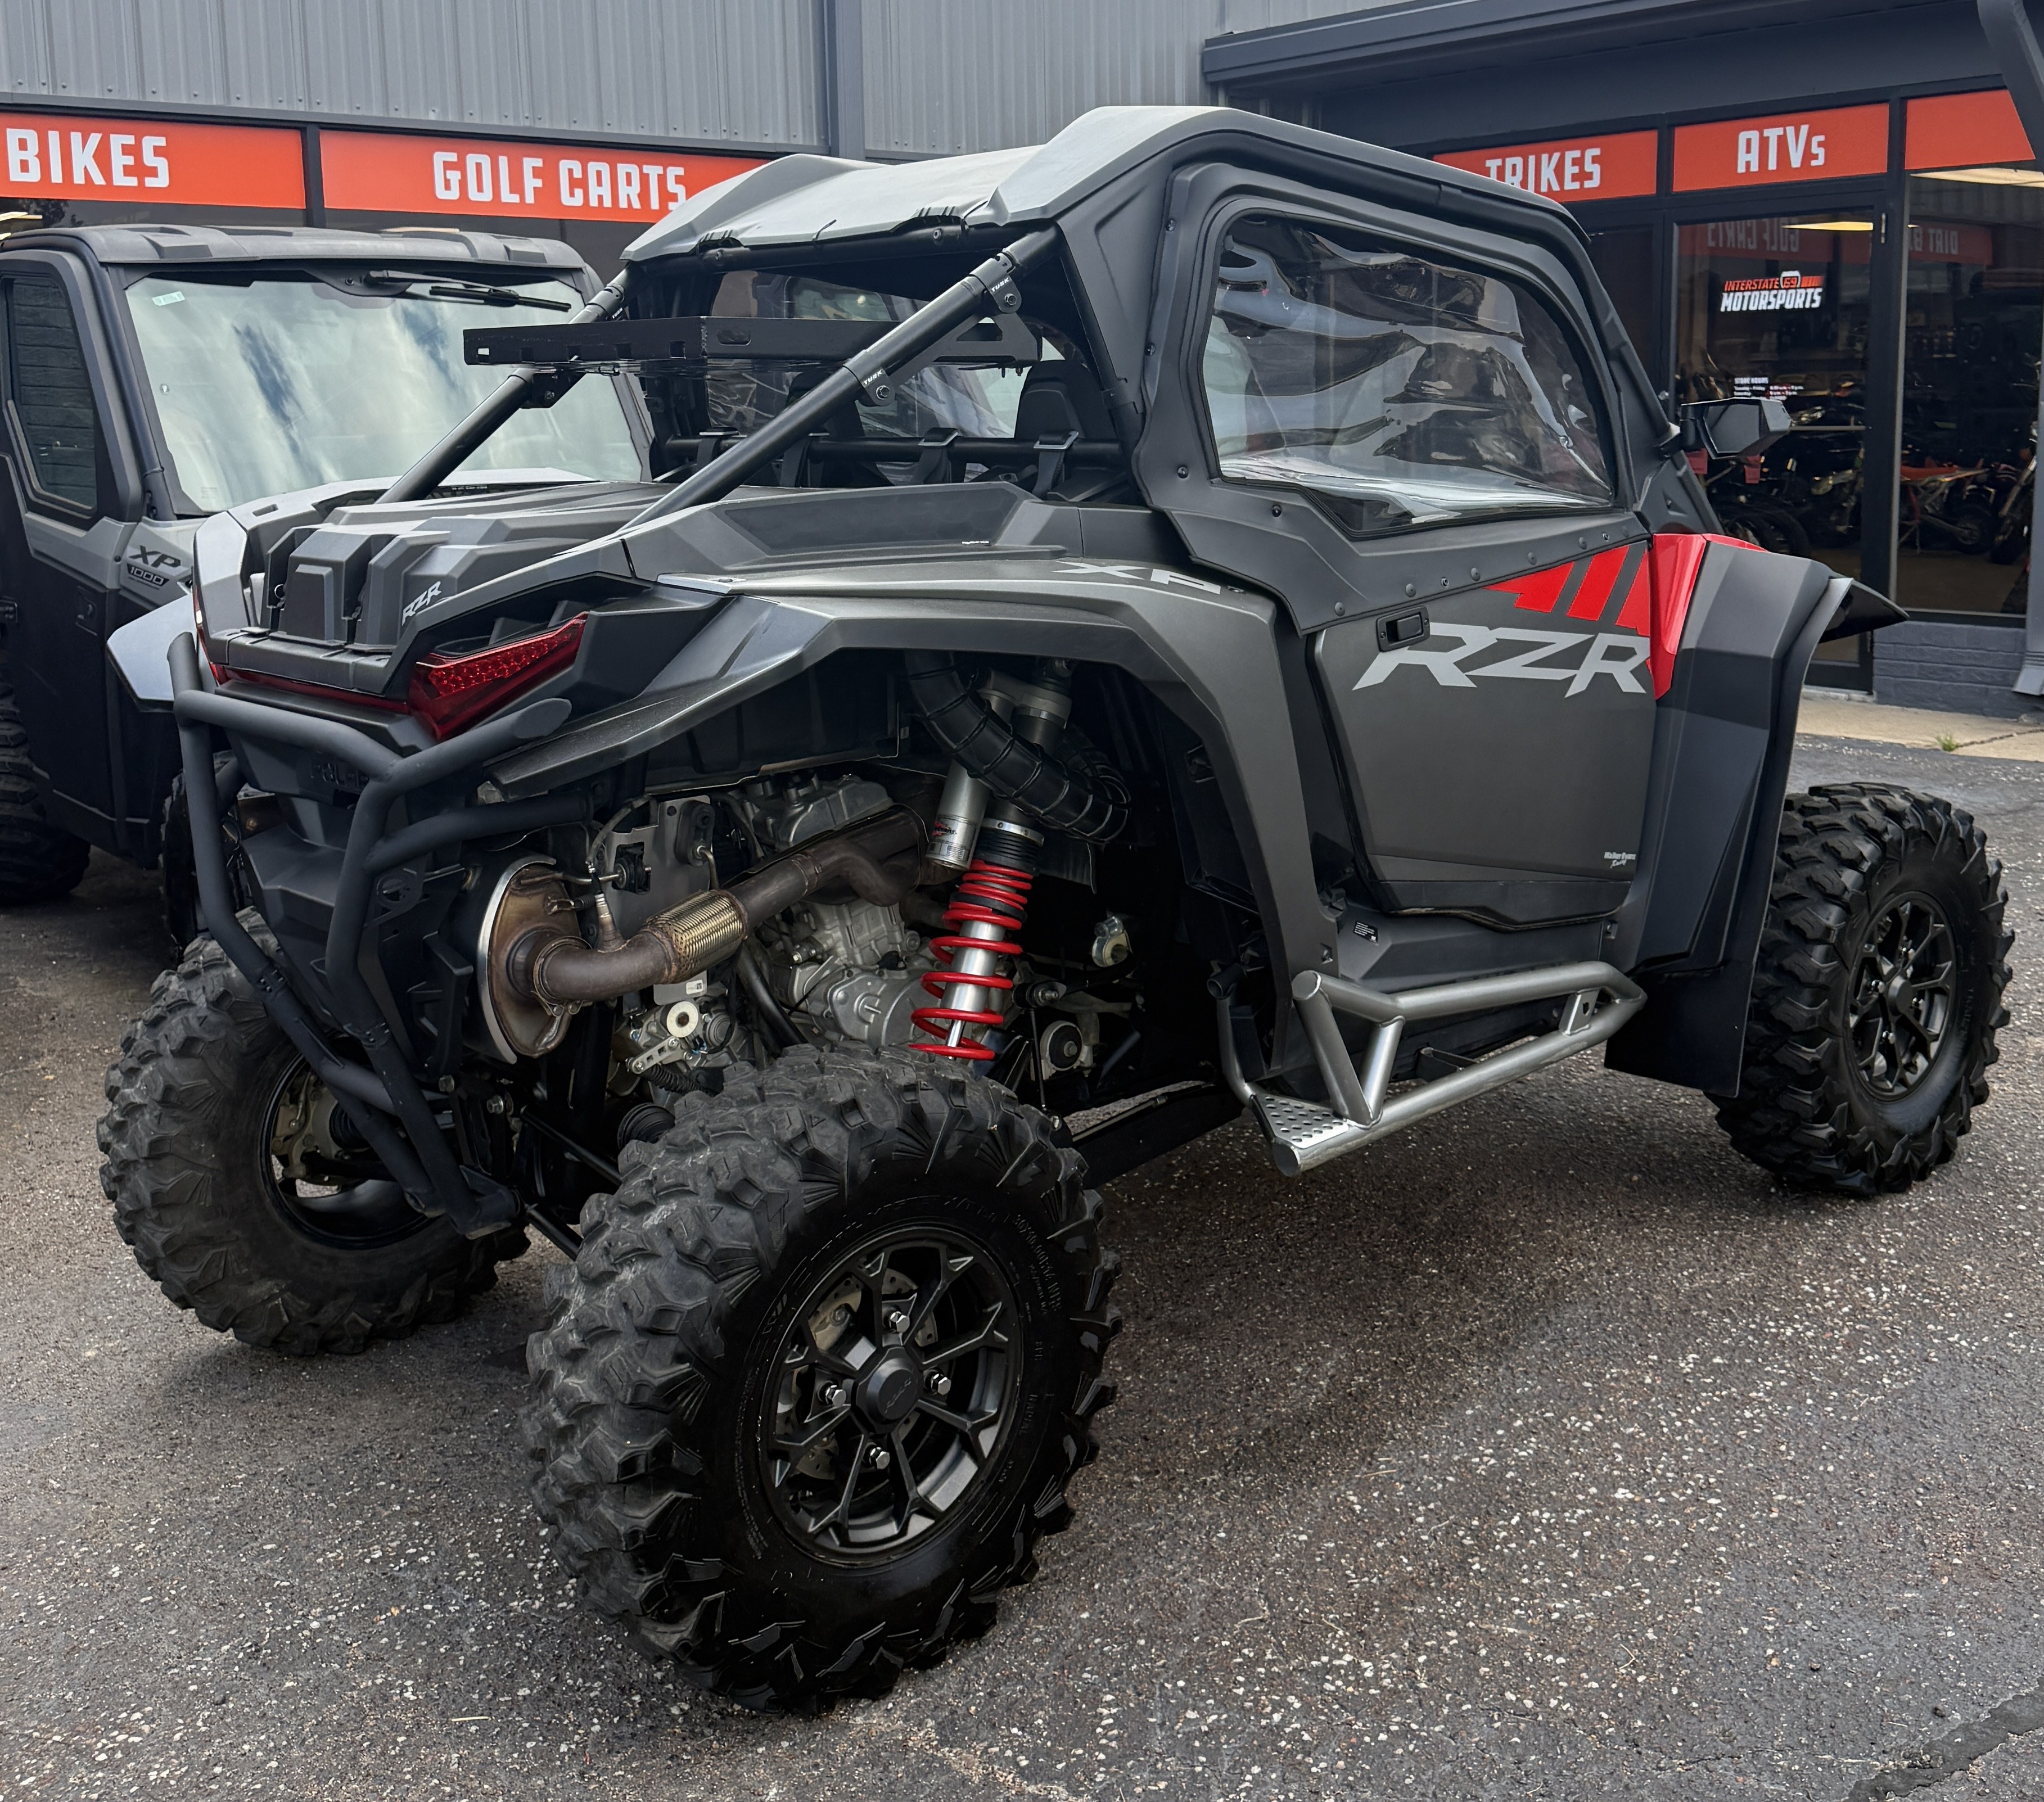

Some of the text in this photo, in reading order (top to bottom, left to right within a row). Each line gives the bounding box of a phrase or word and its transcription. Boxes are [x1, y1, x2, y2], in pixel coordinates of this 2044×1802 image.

[6, 128, 170, 188] BIKES
[1485, 147, 1601, 193] TRIKES
[1736, 124, 1826, 174] ATVs
[433, 151, 686, 211] GOLF CARTS
[991, 277, 1009, 292] TUSK
[1720, 288, 1823, 312] MOTORSPORTS
[1723, 277, 1798, 291] INTERSTATE 69
[128, 545, 181, 568] XP
[130, 566, 164, 586] 1000
[401, 581, 442, 627] RZR
[1352, 621, 1650, 698] RZR
